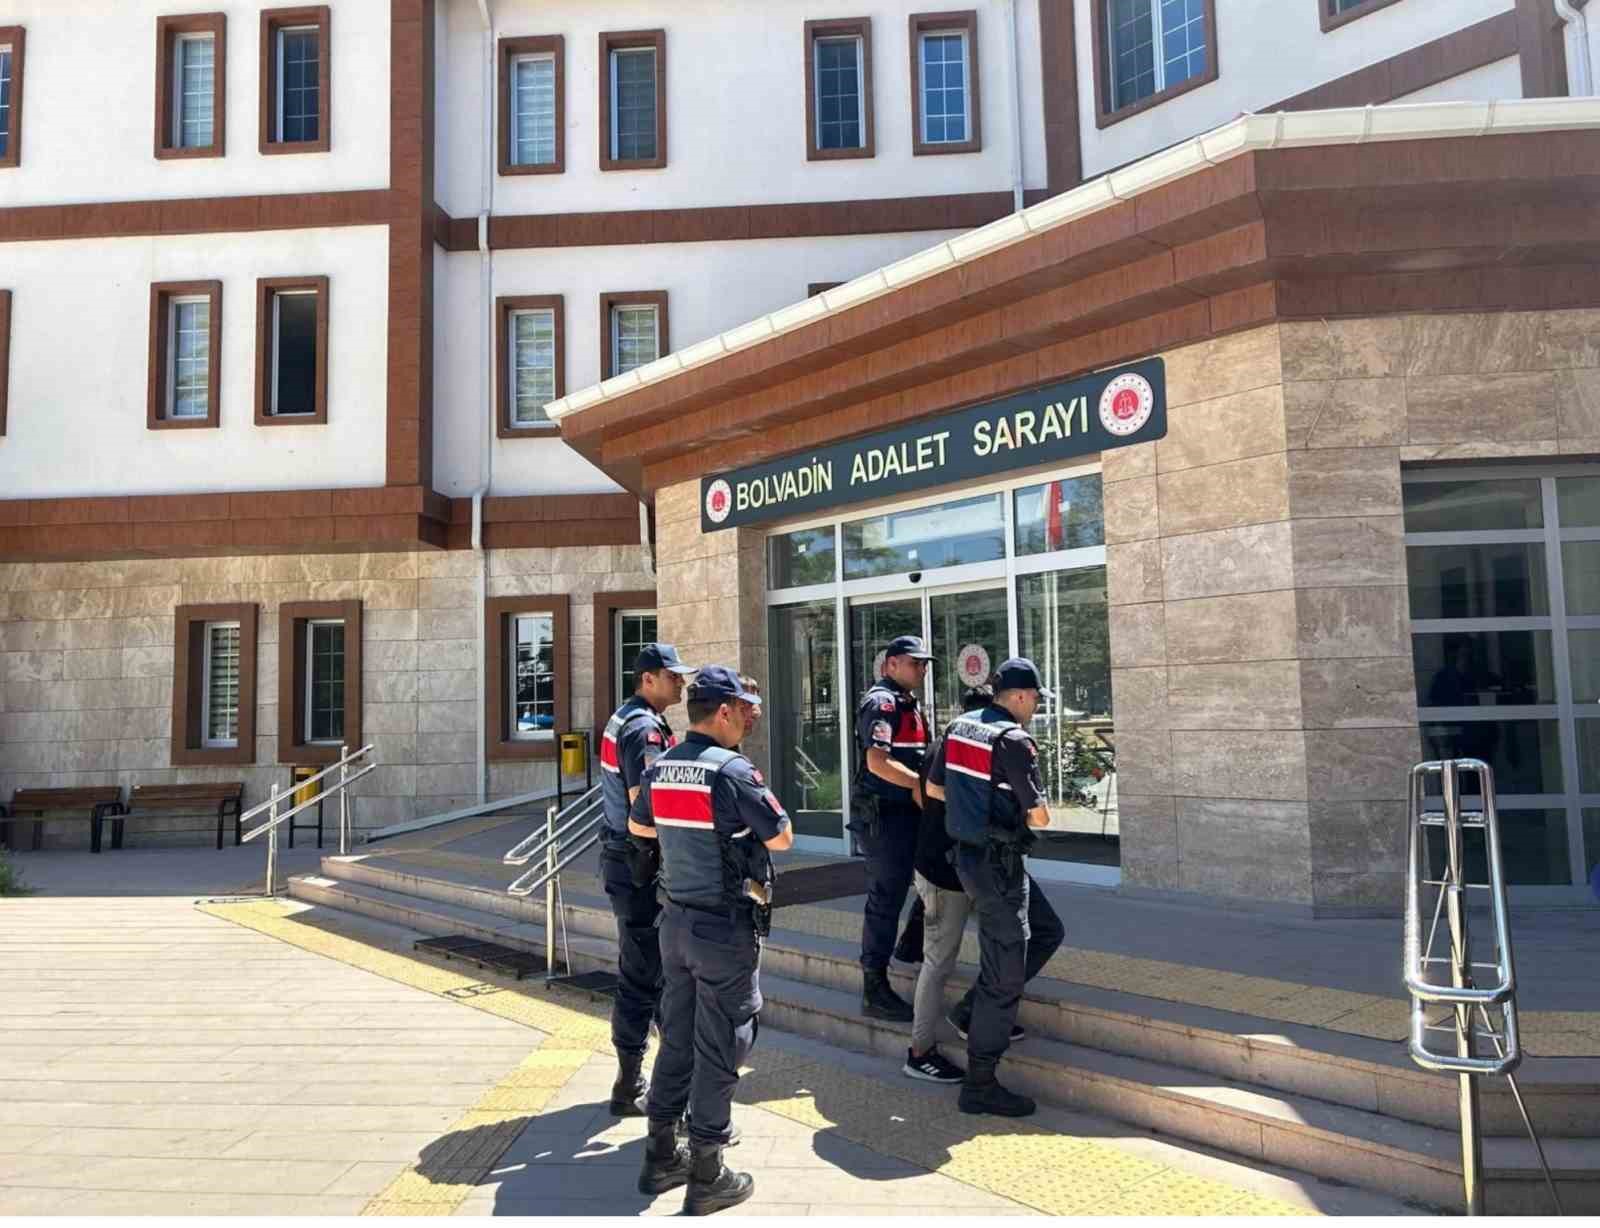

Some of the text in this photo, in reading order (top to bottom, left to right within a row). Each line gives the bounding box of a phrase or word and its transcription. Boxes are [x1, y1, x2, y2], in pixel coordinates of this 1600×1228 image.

[736, 396, 1089, 511] BOLVADİN ADALET SARAYI
[655, 766, 705, 784] JANDARMA
